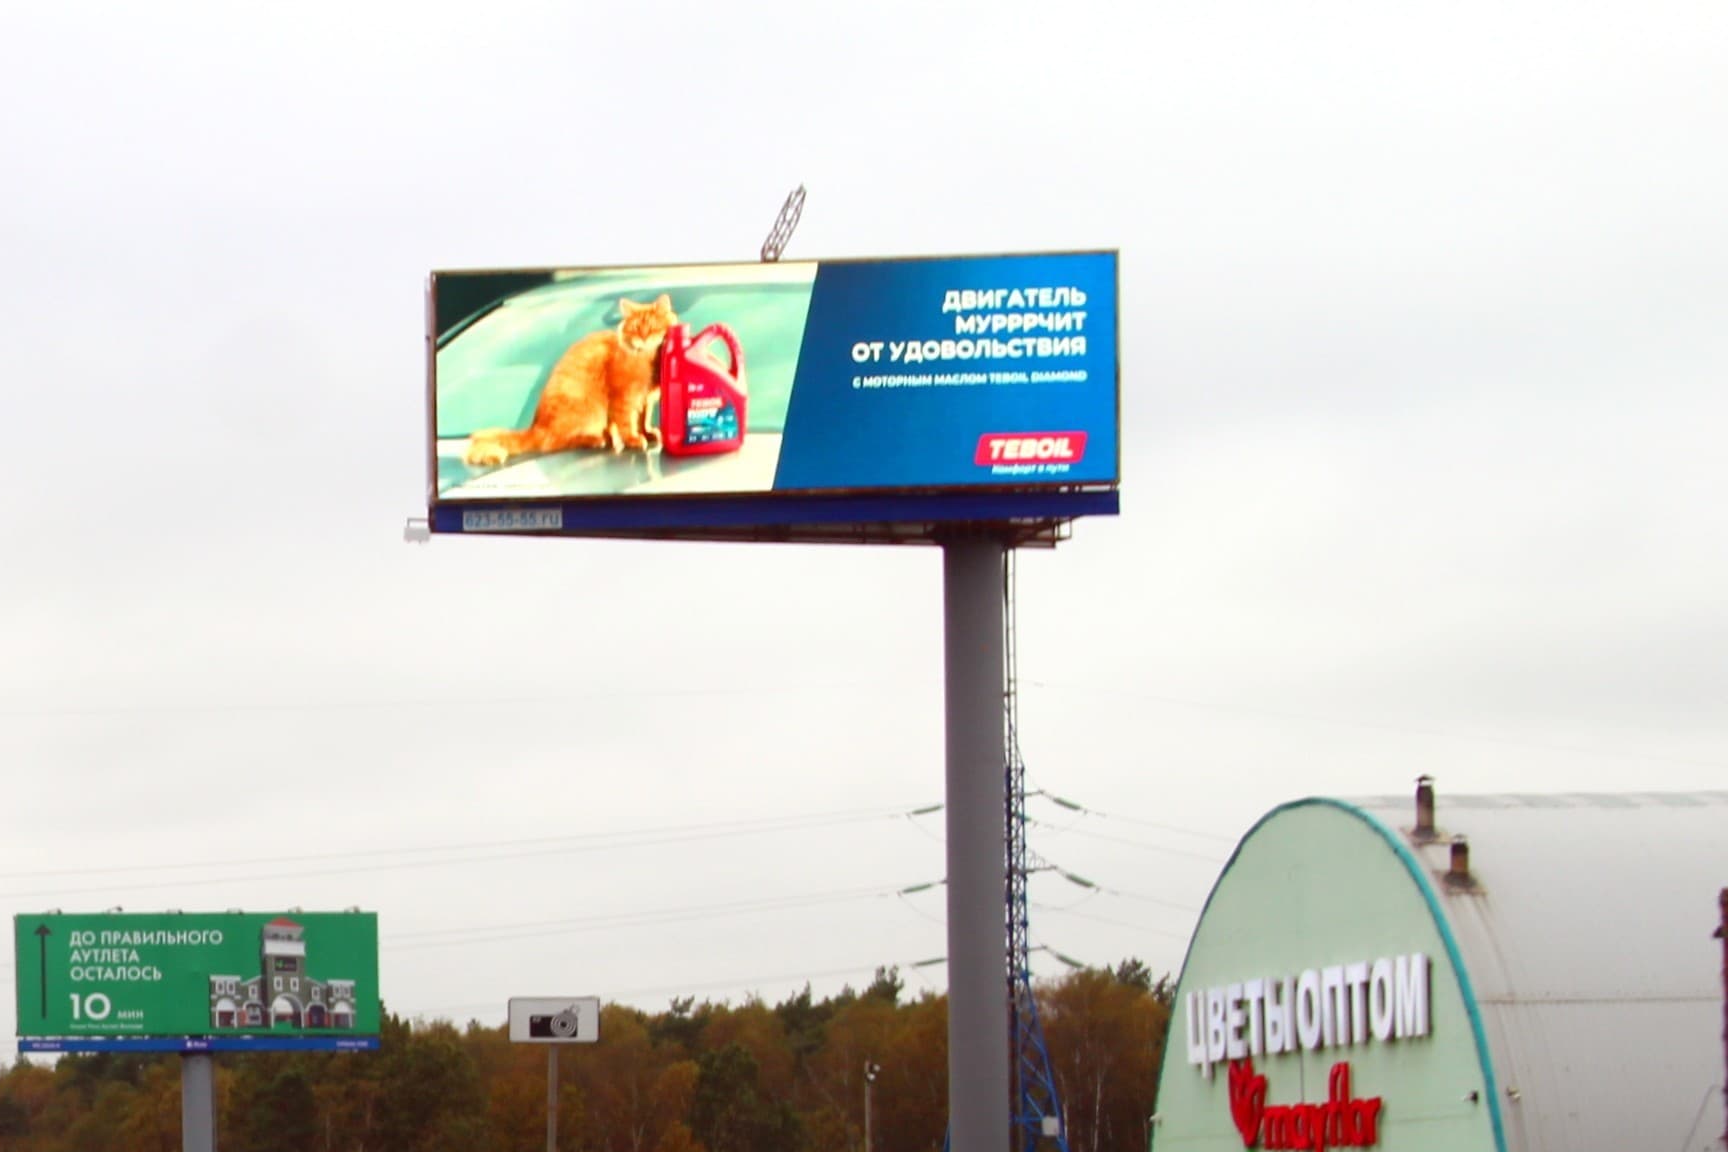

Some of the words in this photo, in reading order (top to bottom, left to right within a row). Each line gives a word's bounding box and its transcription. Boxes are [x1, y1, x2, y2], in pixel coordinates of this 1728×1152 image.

[942, 287, 1087, 313] ДВИГАТЕЛЬ
[955, 312, 1087, 334] МУРРРЧИТ
[852, 342, 884, 363] ОТ
[889, 336, 1087, 364] УДОВОЛЬСТВИЯ
[863, 374, 932, 388] МОТОРНЫМ
[934, 372, 987, 386] МАСЛОМ
[989, 437, 1073, 460] TEBOIL
[70, 930, 96, 948] ДО
[100, 930, 223, 946] ПРАВИЛЬНОГО
[70, 949, 140, 963] АУТЛЕТА
[70, 966, 162, 981] ОСТАЛОСЬ
[69, 992, 111, 1020] 10
